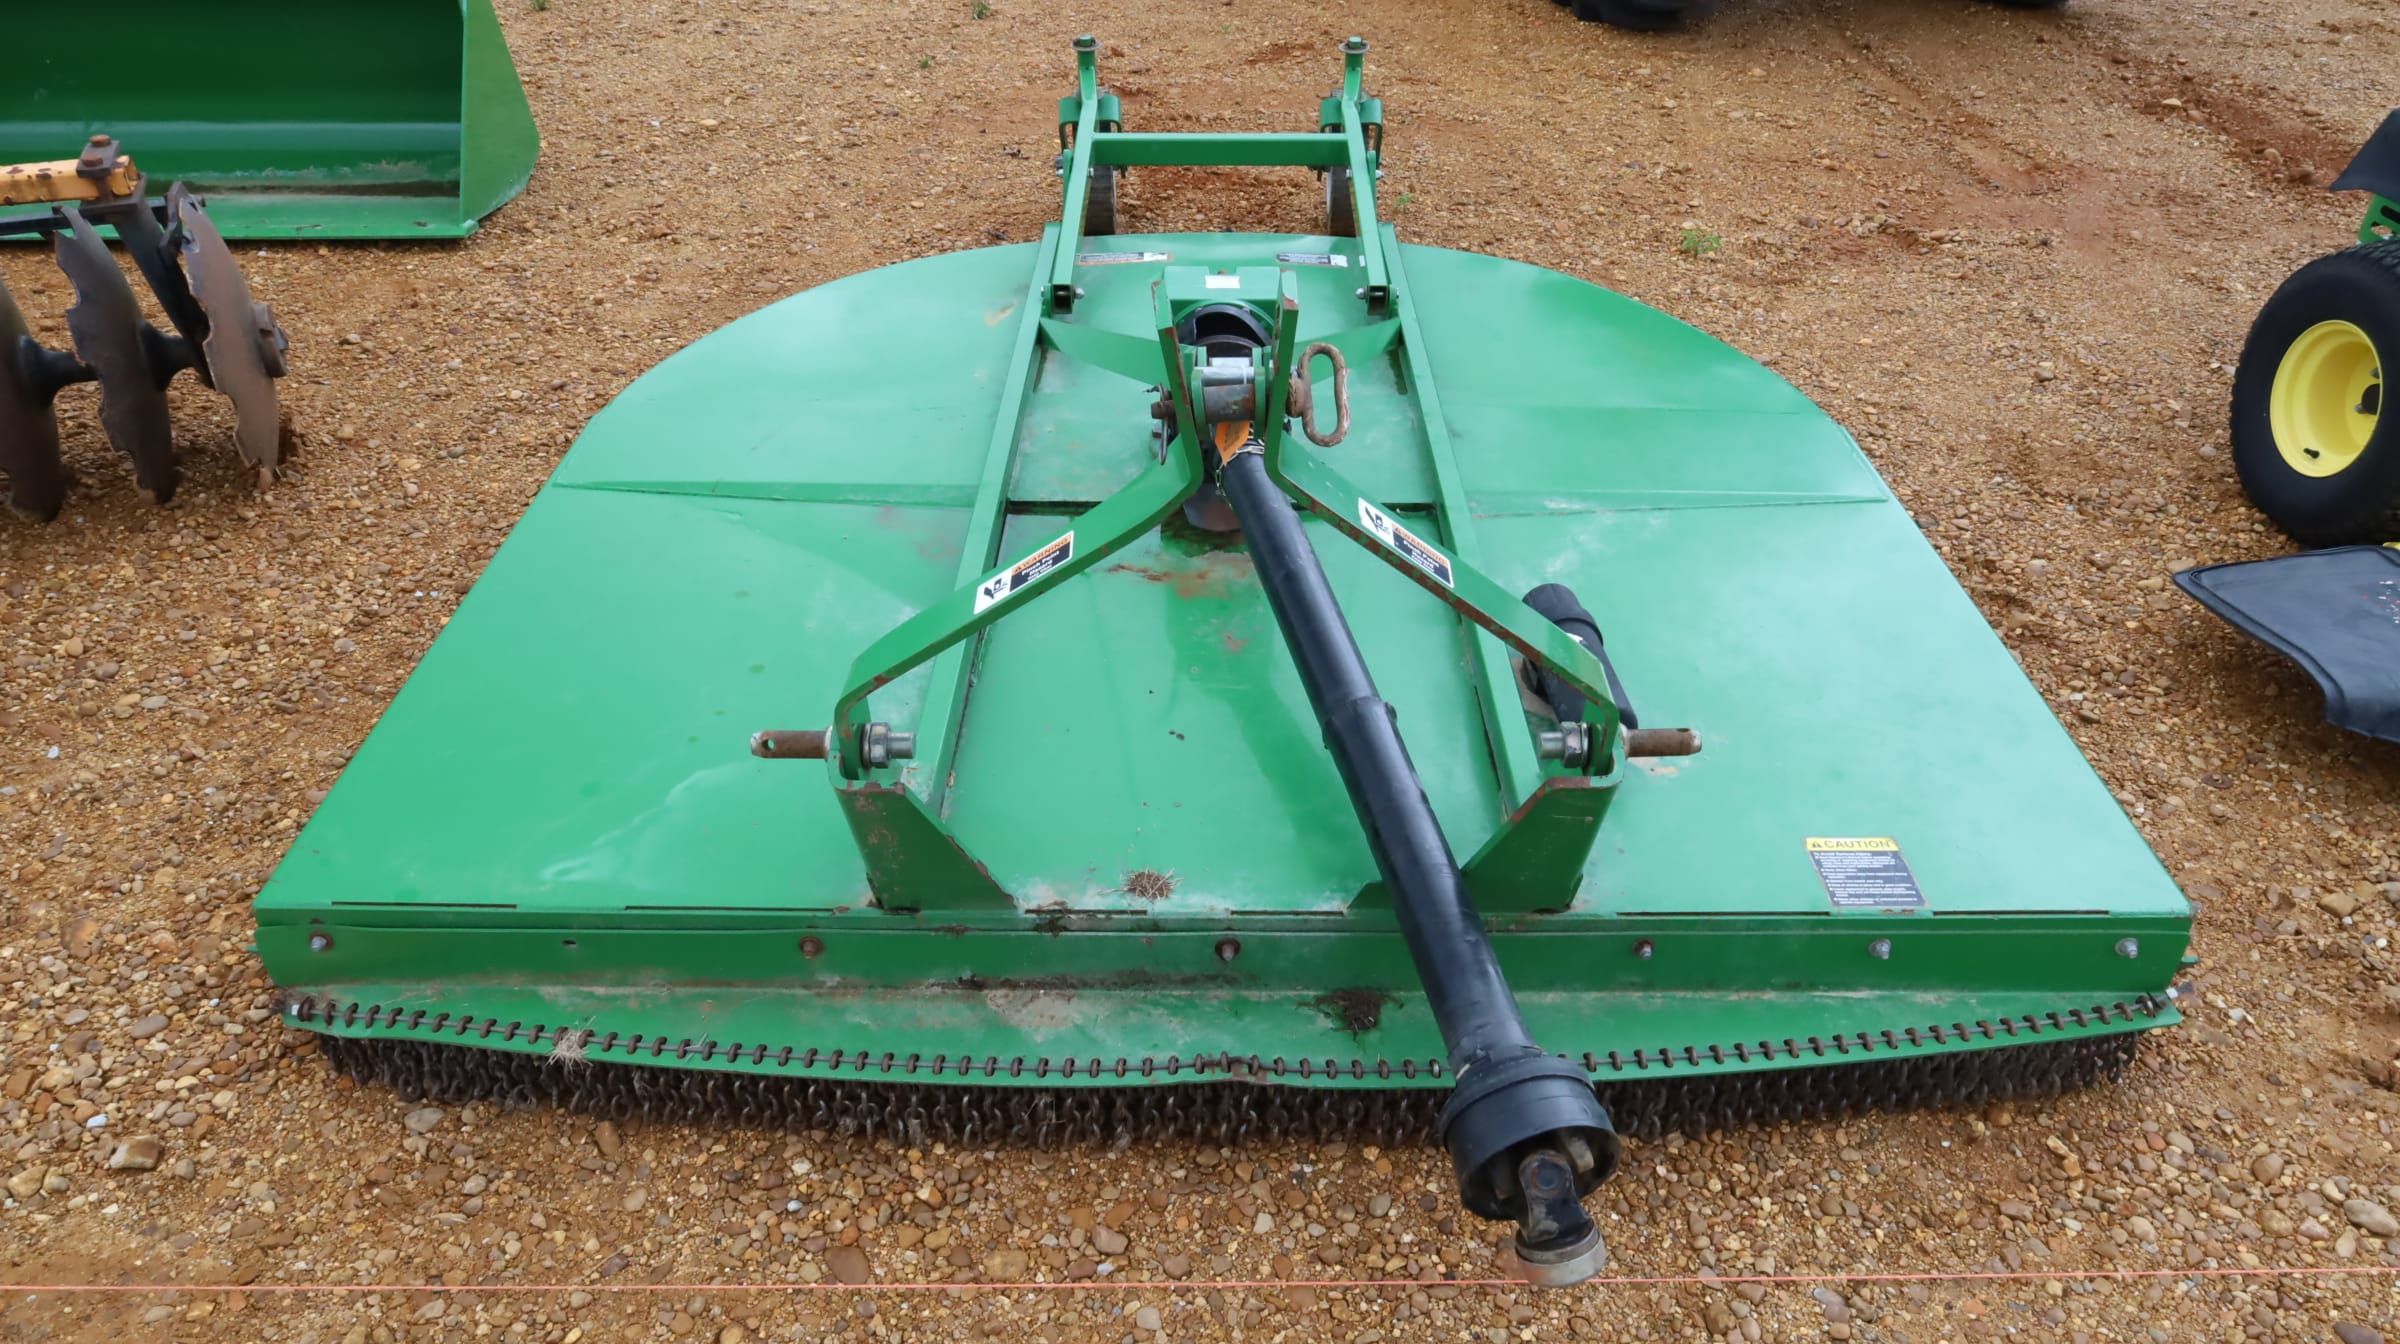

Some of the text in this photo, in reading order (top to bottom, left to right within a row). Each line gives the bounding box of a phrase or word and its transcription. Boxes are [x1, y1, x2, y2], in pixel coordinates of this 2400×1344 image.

[1021, 550, 1060, 576] Pinch Point
[1824, 839, 1892, 849] CAUTION
